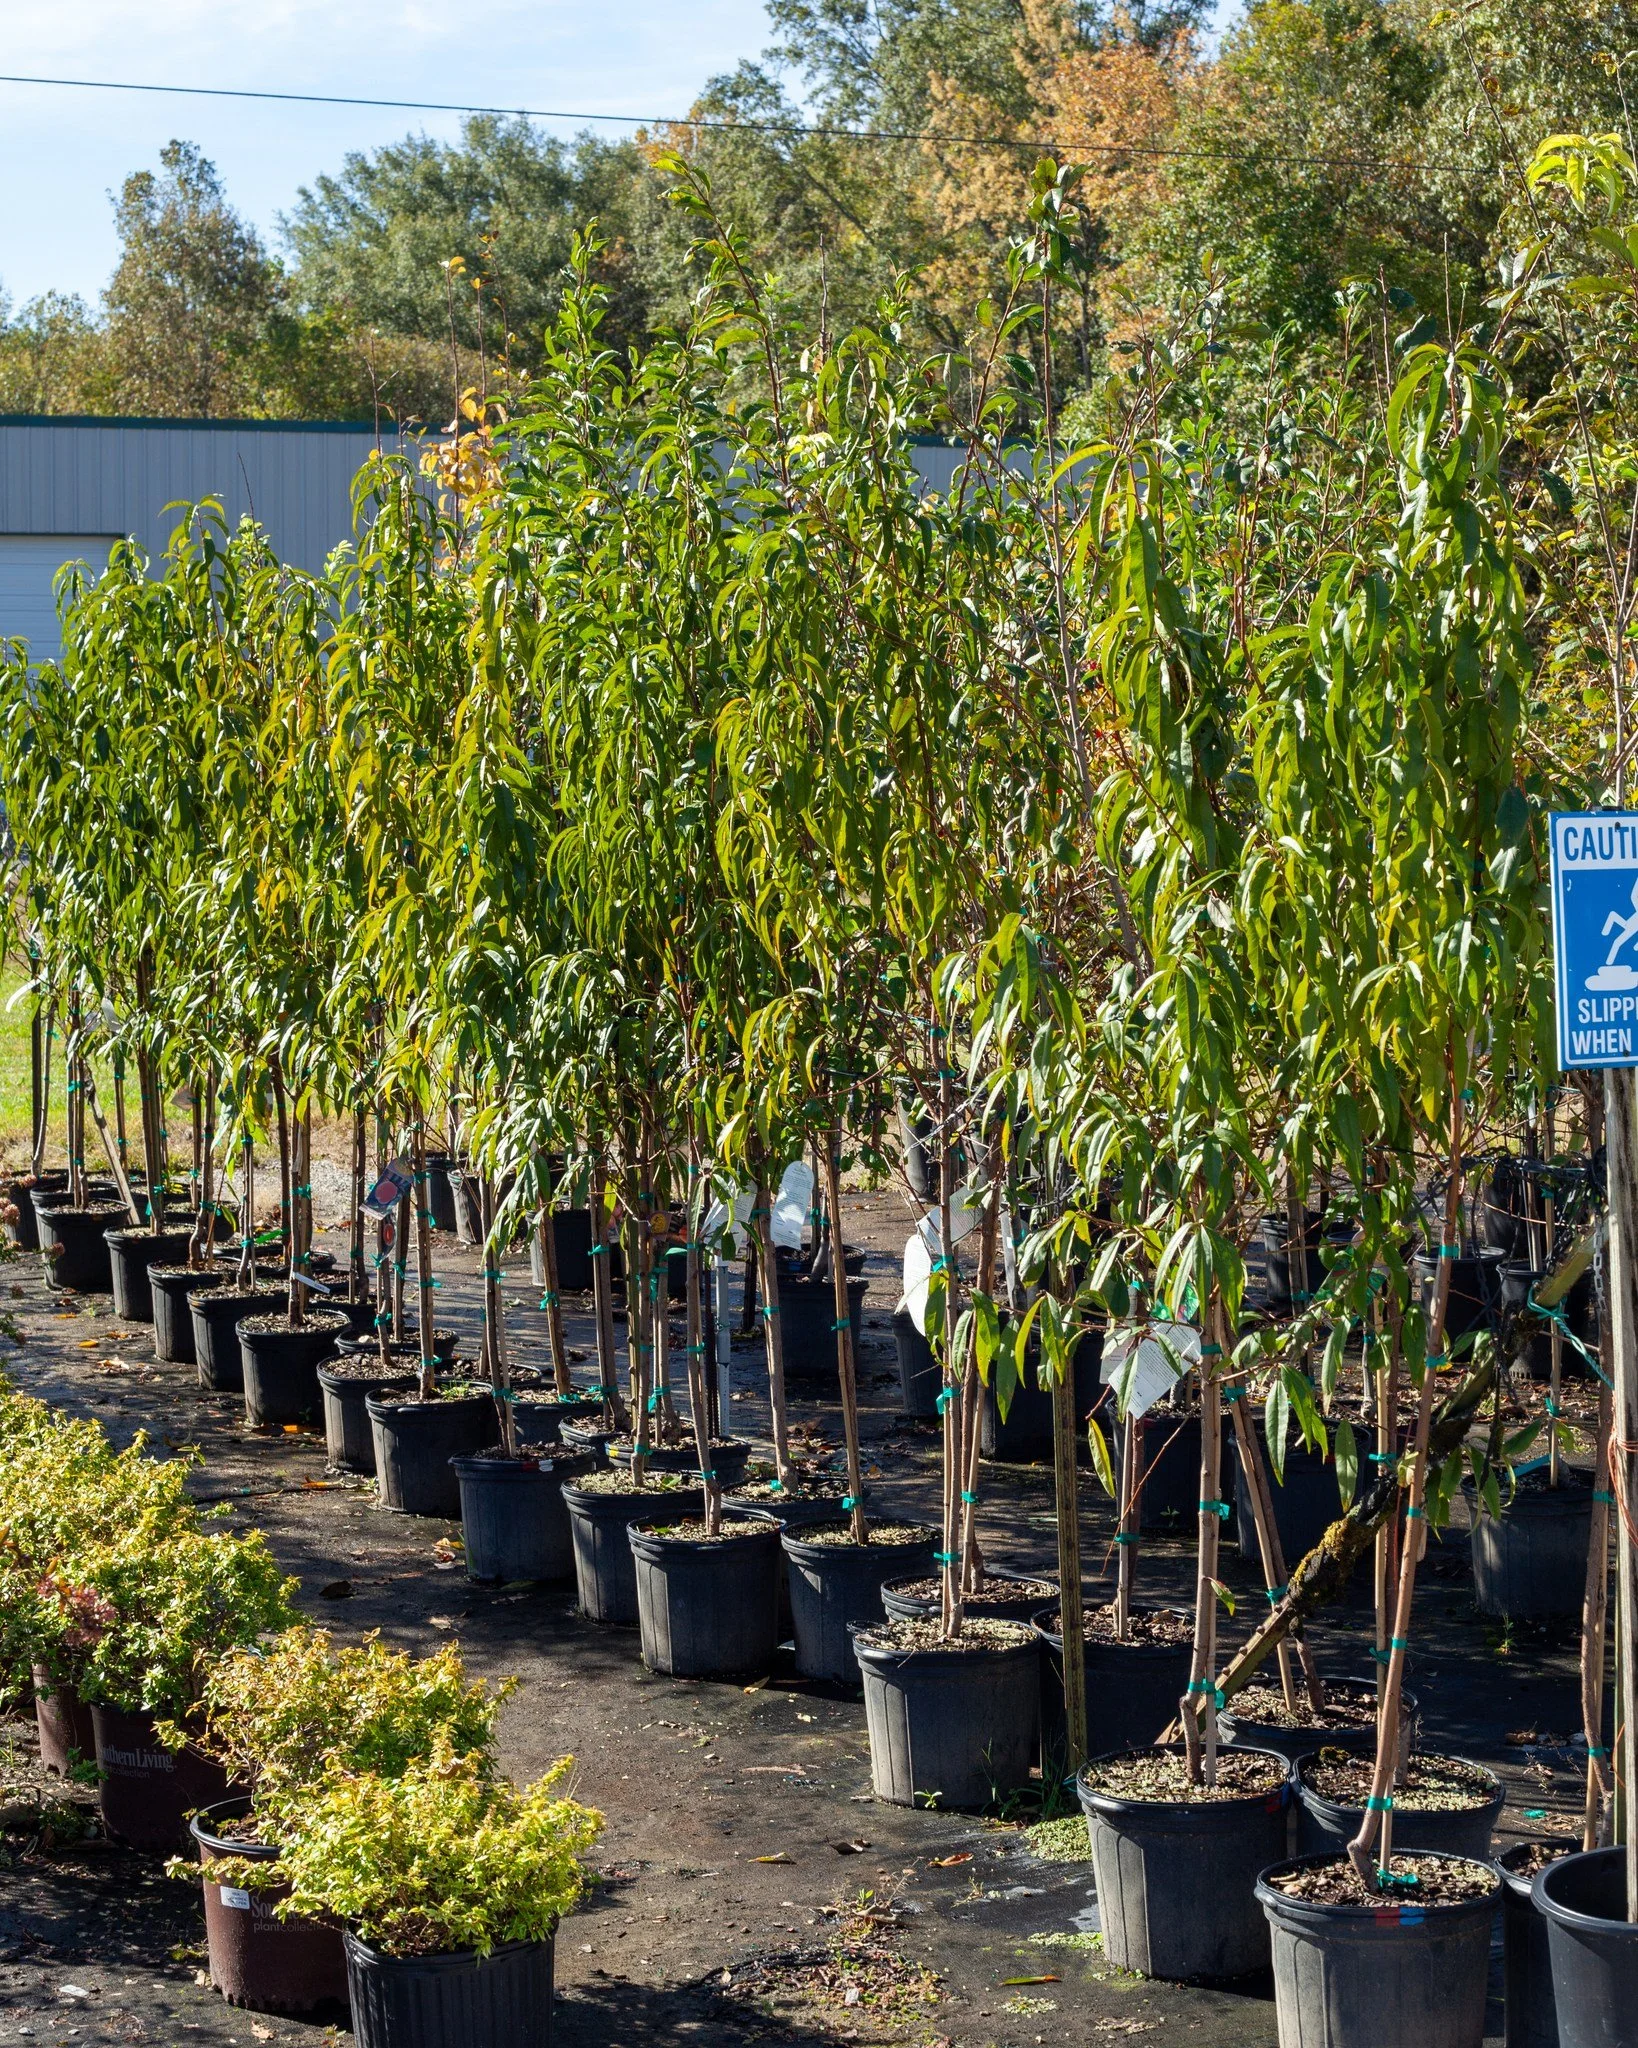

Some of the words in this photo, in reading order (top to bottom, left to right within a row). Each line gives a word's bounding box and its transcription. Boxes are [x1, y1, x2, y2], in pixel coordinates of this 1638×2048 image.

[1563, 826, 1637, 861] CAUTI
[1578, 996, 1638, 1024] SLIPP
[1571, 1028, 1632, 1055] WHEN
[135, 1748, 174, 1773] Living
